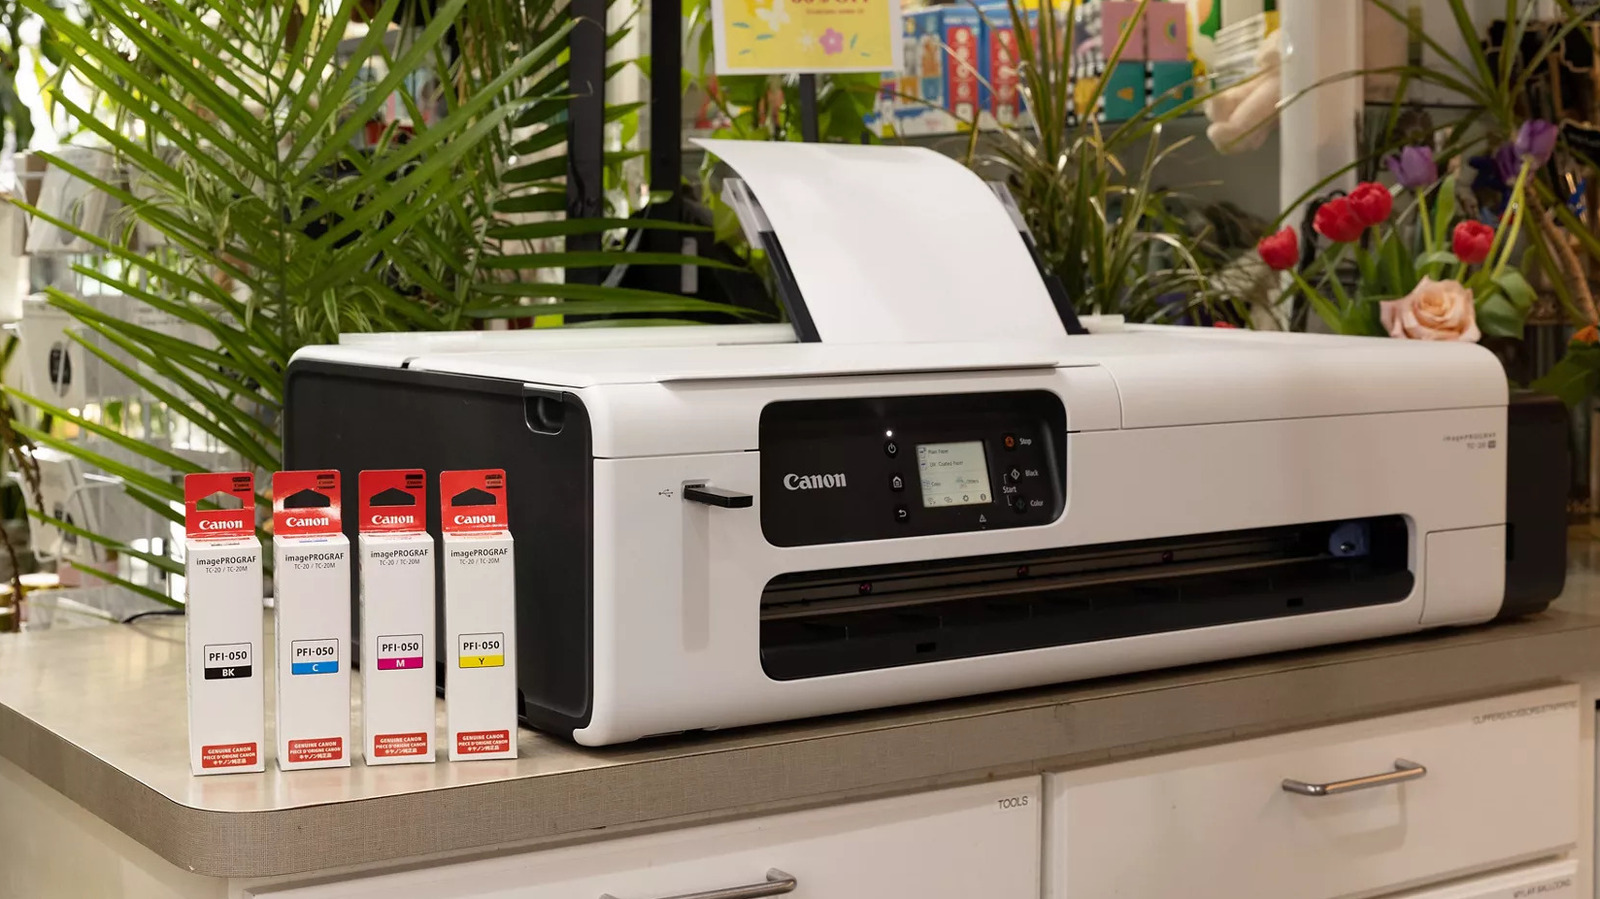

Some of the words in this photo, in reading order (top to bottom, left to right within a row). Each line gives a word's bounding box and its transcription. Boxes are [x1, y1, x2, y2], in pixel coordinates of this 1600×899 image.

[1019, 438, 1032, 446] Stop
[783, 472, 847, 491] Canon
[1002, 486, 1017, 494] Start
[286, 516, 329, 527] Canon
[371, 514, 414, 525] Canon
[454, 514, 496, 525] Canon
[198, 520, 243, 530] Canon
[285, 553, 344, 562] imagePROGRAF
[370, 549, 429, 559] imagePROGRAF
[450, 548, 508, 558] imagePROGRAF
[196, 556, 256, 566] imagePROGRAF
[382, 642, 419, 653] PFI-050
[463, 641, 500, 651] PFI-050
[209, 650, 247, 661] PFI-050
[296, 646, 334, 657] PFI-050
[222, 668, 235, 677] BK
[312, 664, 318, 672] C
[998, 796, 1028, 809] TOOLS
